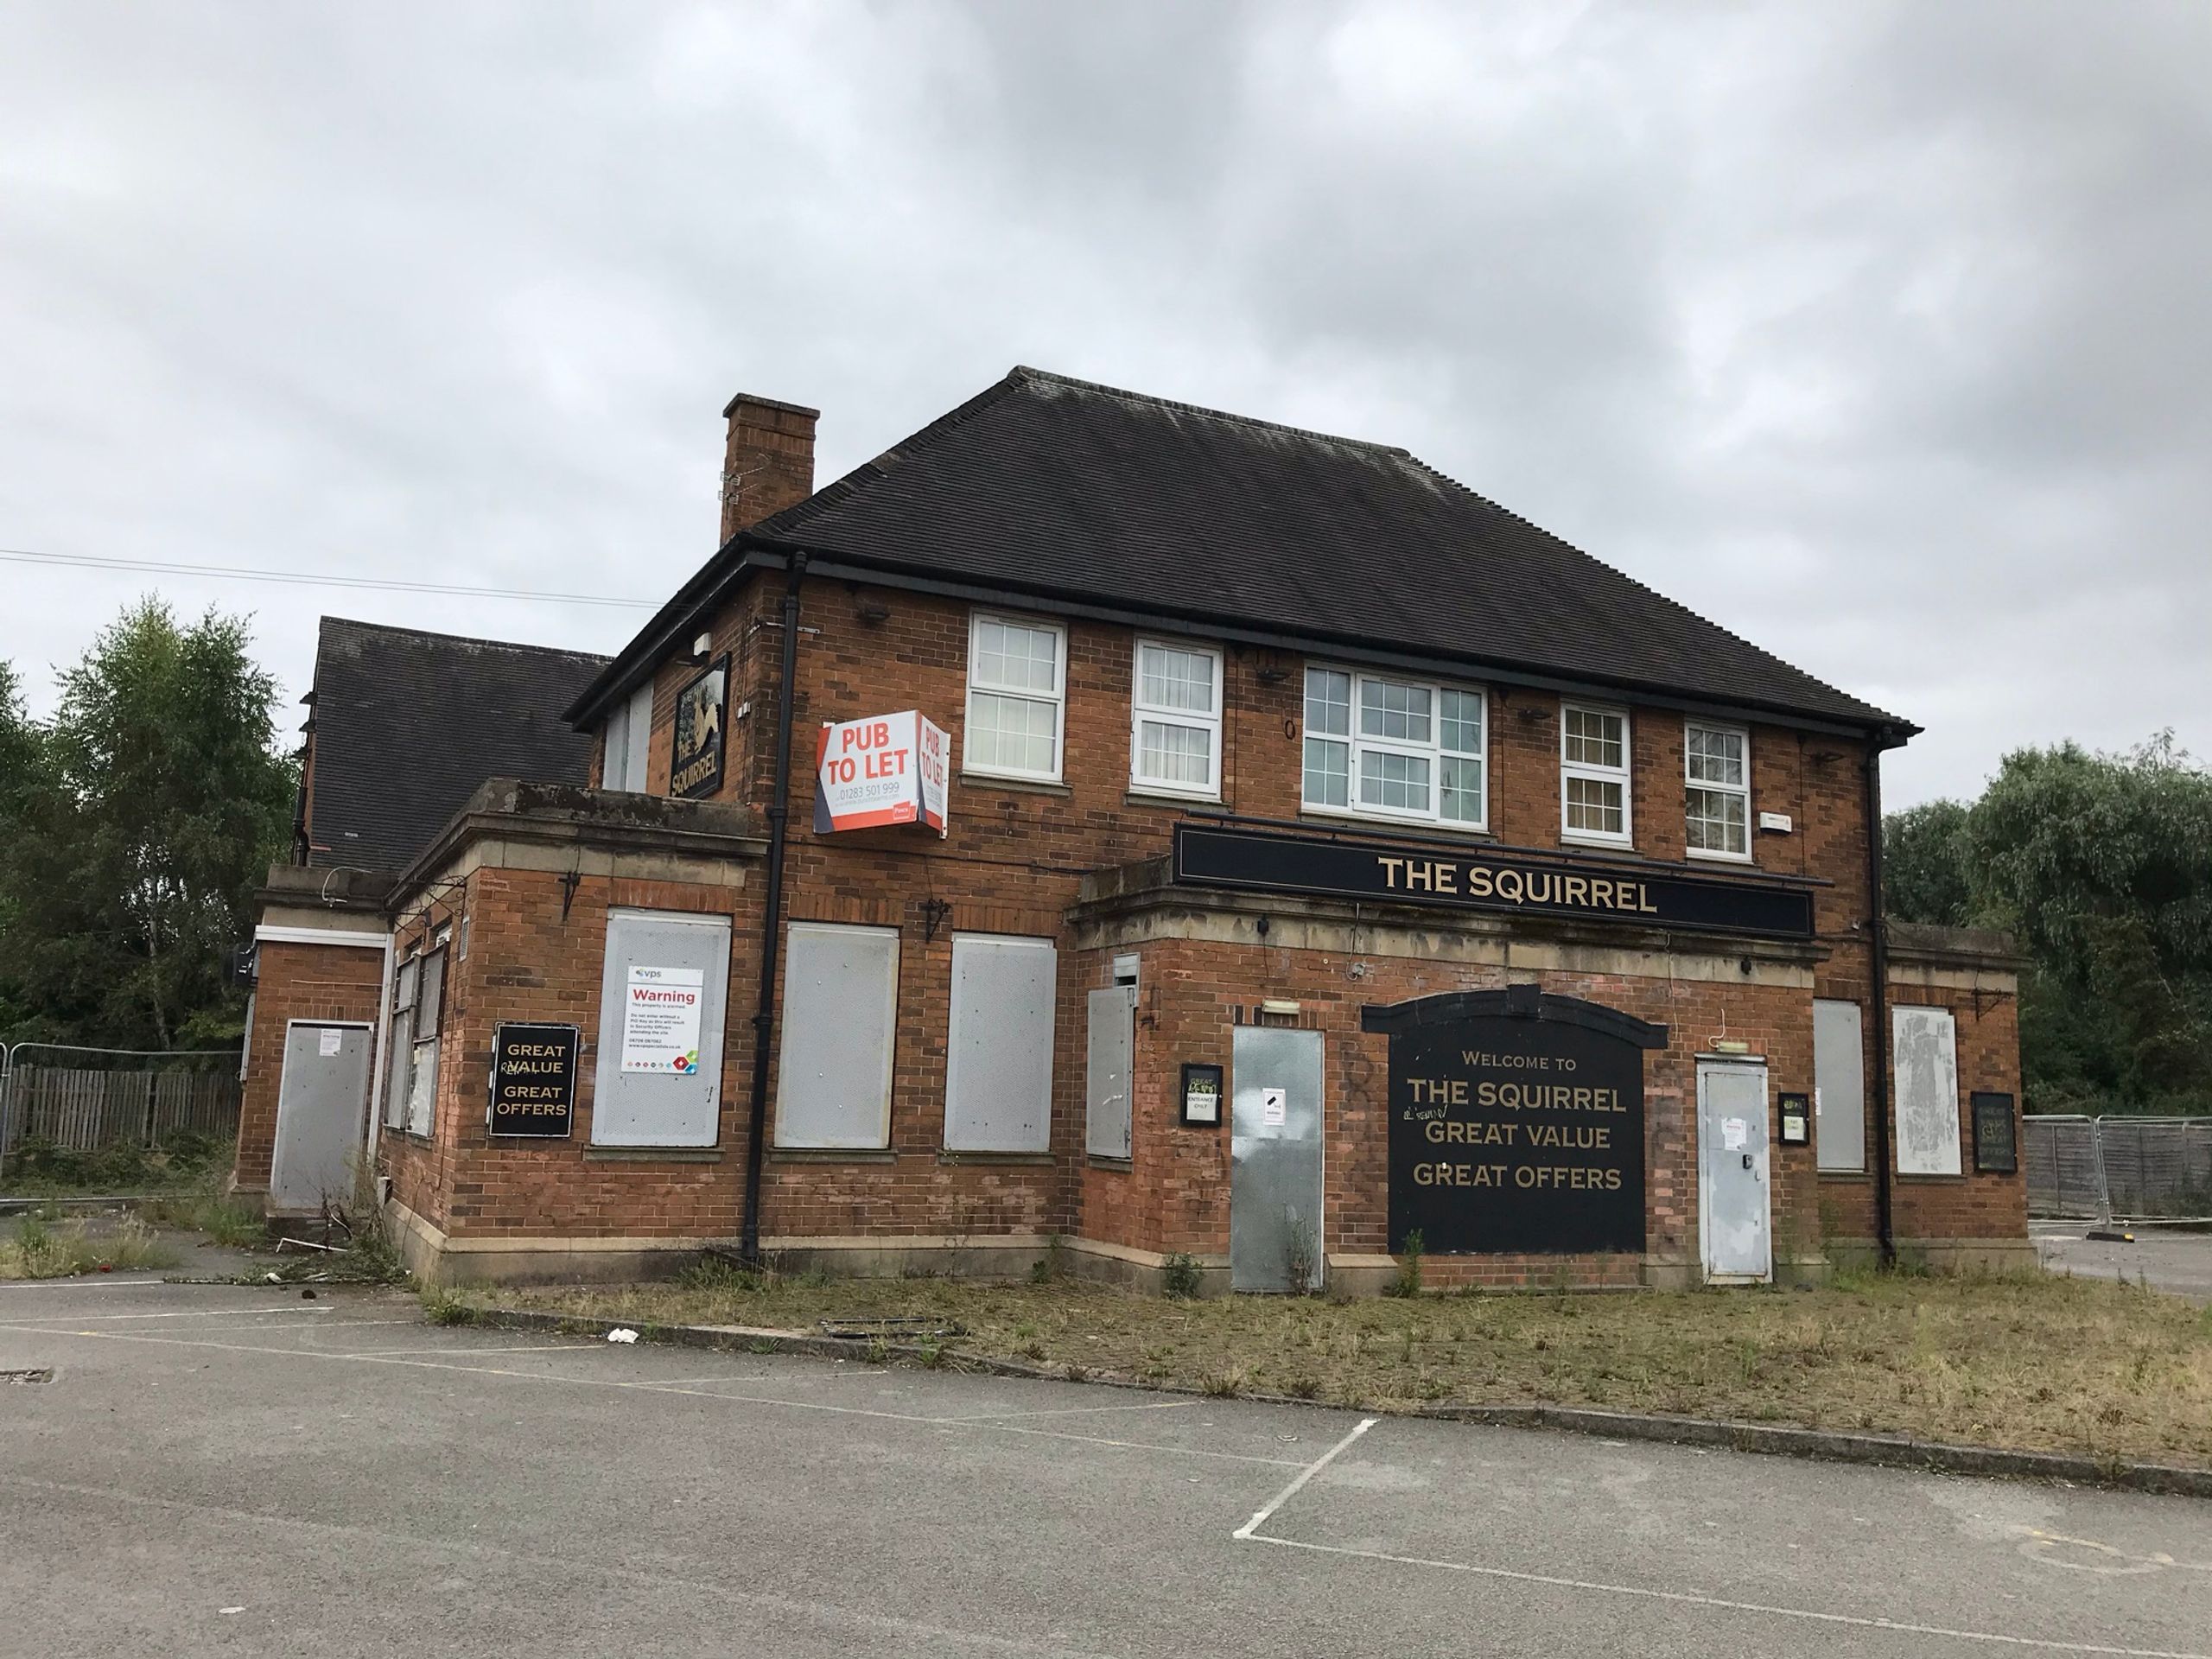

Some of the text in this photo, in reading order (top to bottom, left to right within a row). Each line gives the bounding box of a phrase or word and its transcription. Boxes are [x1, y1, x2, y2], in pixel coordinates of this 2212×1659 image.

[677, 739, 695, 763] THE
[842, 722, 889, 753] PUB
[926, 726, 940, 758] PUB
[672, 750, 716, 797] SQUIRREL
[828, 749, 908, 785] TO LET
[922, 751, 944, 788] TO LET
[840, 782, 899, 800] 01283 501 999
[1378, 856, 1658, 913] THE SQUIRREL
[633, 988, 695, 1005] Warning
[507, 1044, 566, 1057] GREAT
[508, 1061, 563, 1073] VALUE
[1555, 1058, 1576, 1071] TO
[504, 1086, 563, 1099] GREAT
[1407, 1078, 1469, 1105] THE
[1478, 1082, 1627, 1113] SQUIRREL
[497, 1103, 567, 1116] OFFERS
[1426, 1121, 1611, 1148] GREAT VALUE
[1414, 1163, 1622, 1190] GREAT OFFERS
